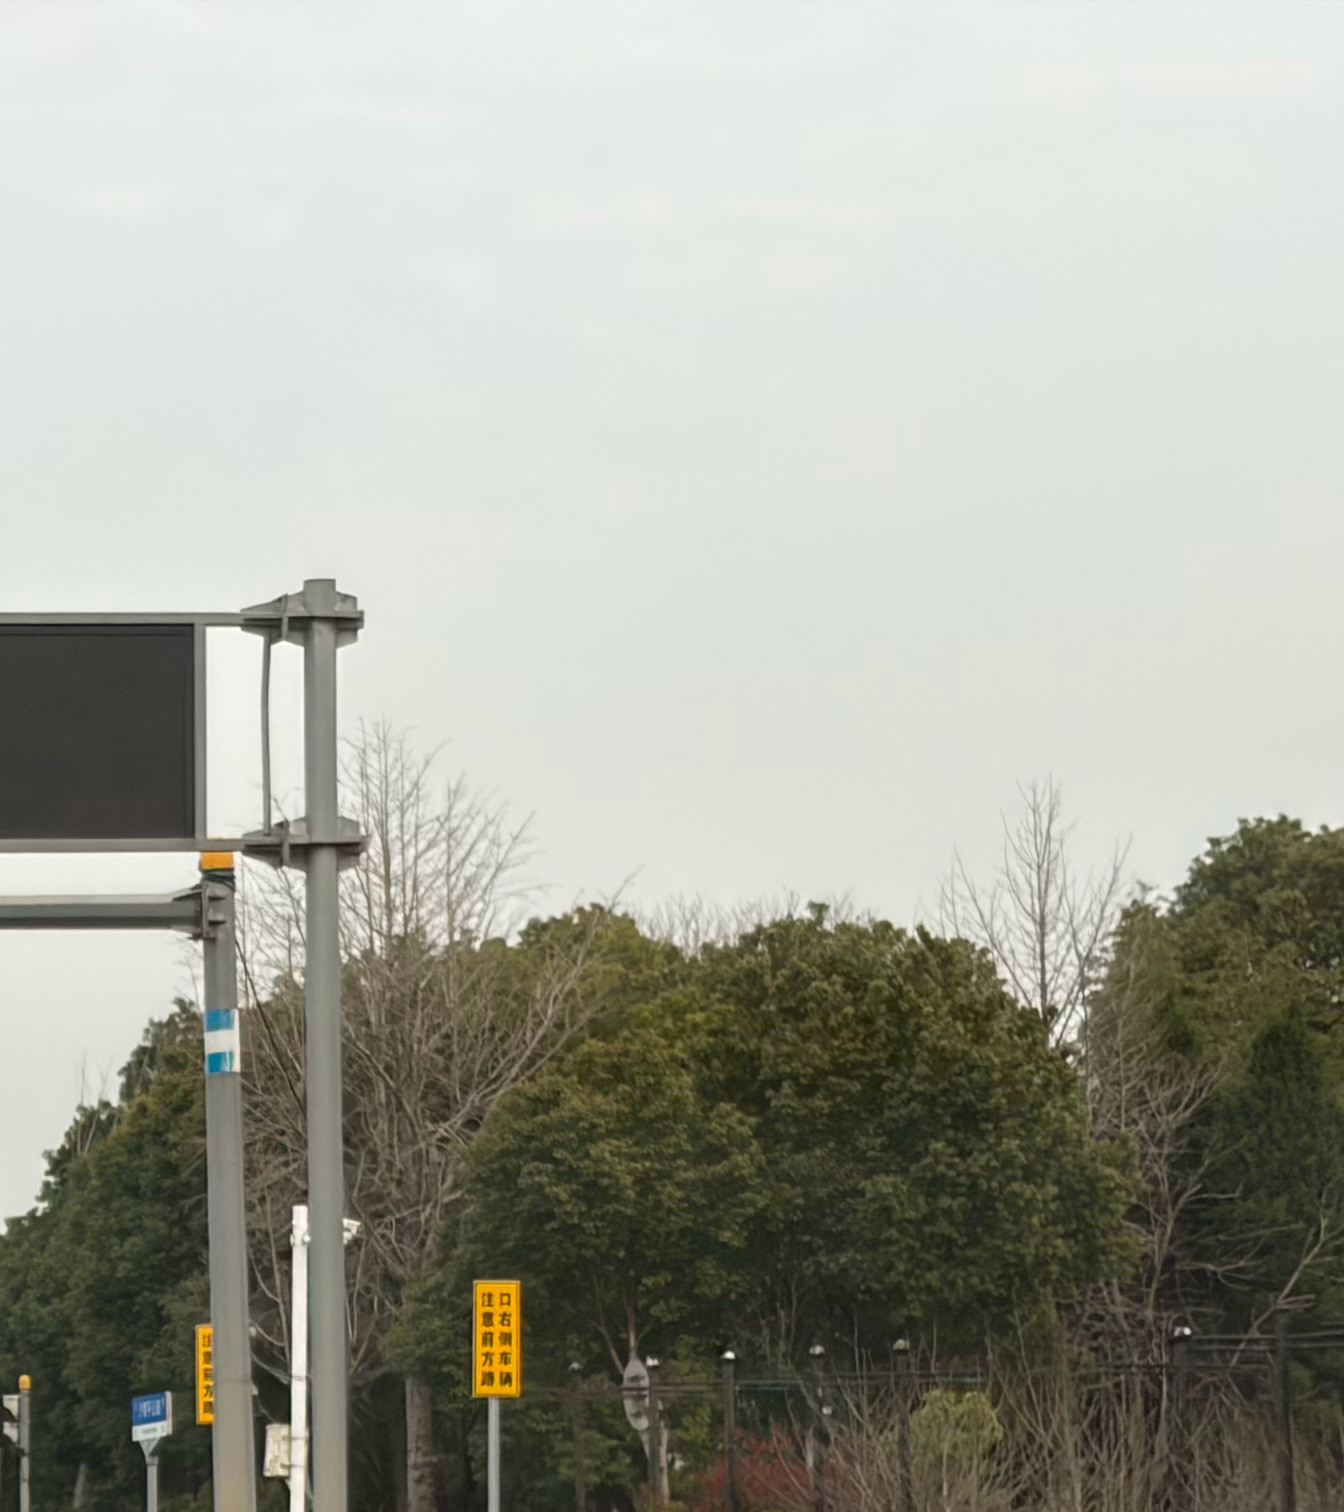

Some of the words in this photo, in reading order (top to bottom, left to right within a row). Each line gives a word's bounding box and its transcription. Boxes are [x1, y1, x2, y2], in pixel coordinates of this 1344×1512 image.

[481, 1292, 495, 1387] 注意前方路
[499, 1292, 512, 1387] 口右侧车辆
